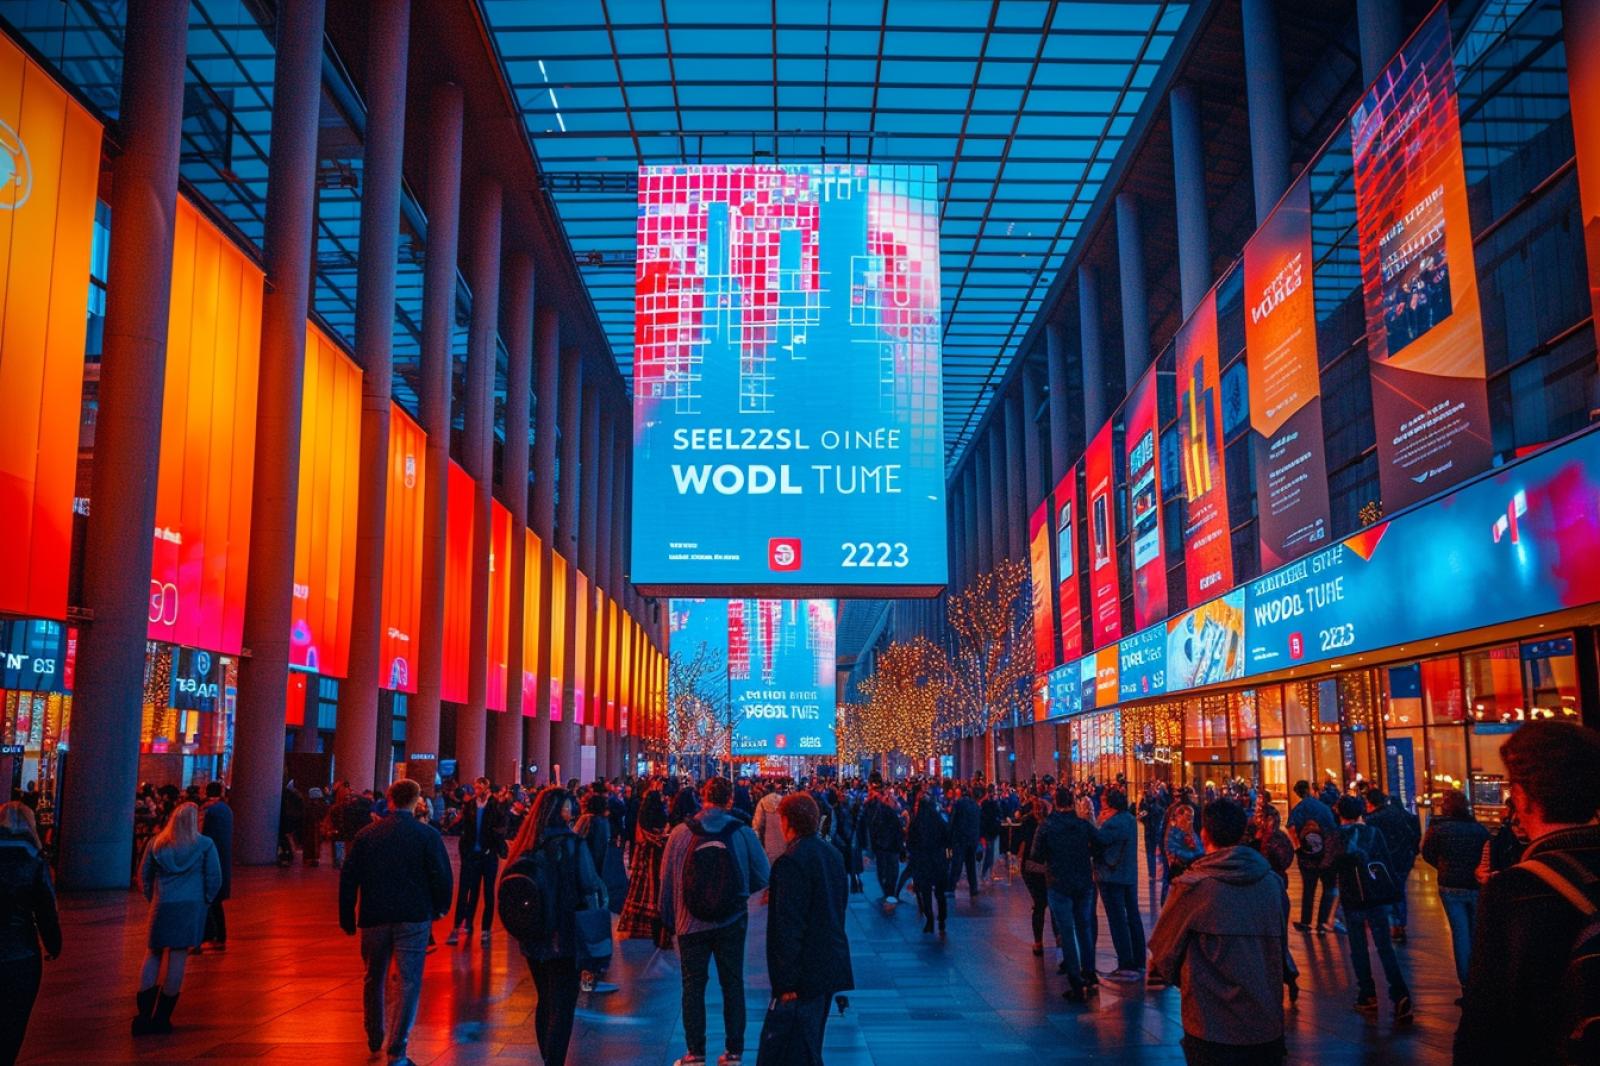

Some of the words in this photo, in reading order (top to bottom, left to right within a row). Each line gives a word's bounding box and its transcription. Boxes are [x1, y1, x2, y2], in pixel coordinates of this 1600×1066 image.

[671, 464, 803, 496] WODL
[811, 464, 902, 495] TUME
[840, 541, 910, 568] 2223
